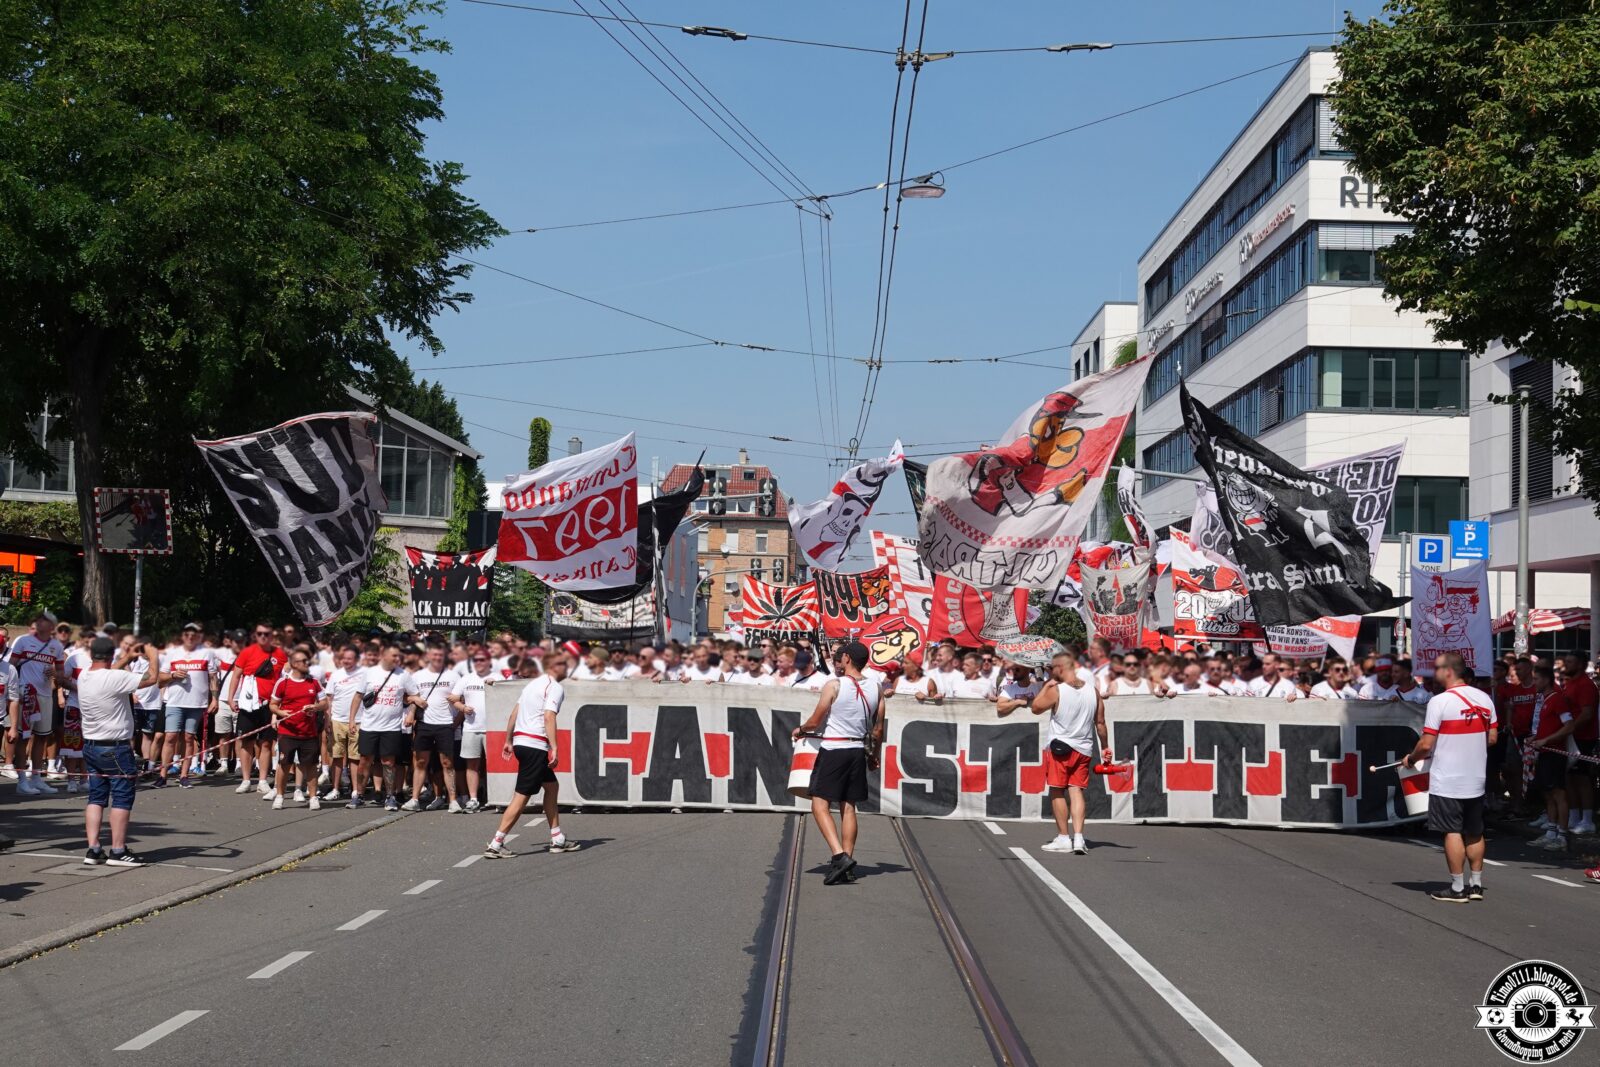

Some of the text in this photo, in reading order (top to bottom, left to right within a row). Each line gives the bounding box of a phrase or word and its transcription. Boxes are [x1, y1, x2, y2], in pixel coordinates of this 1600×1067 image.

[1424, 542, 1438, 560] P
[1420, 565, 1441, 573] ZONE
[437, 601, 450, 616] in
[573, 703, 1421, 824] CANSTTTER
